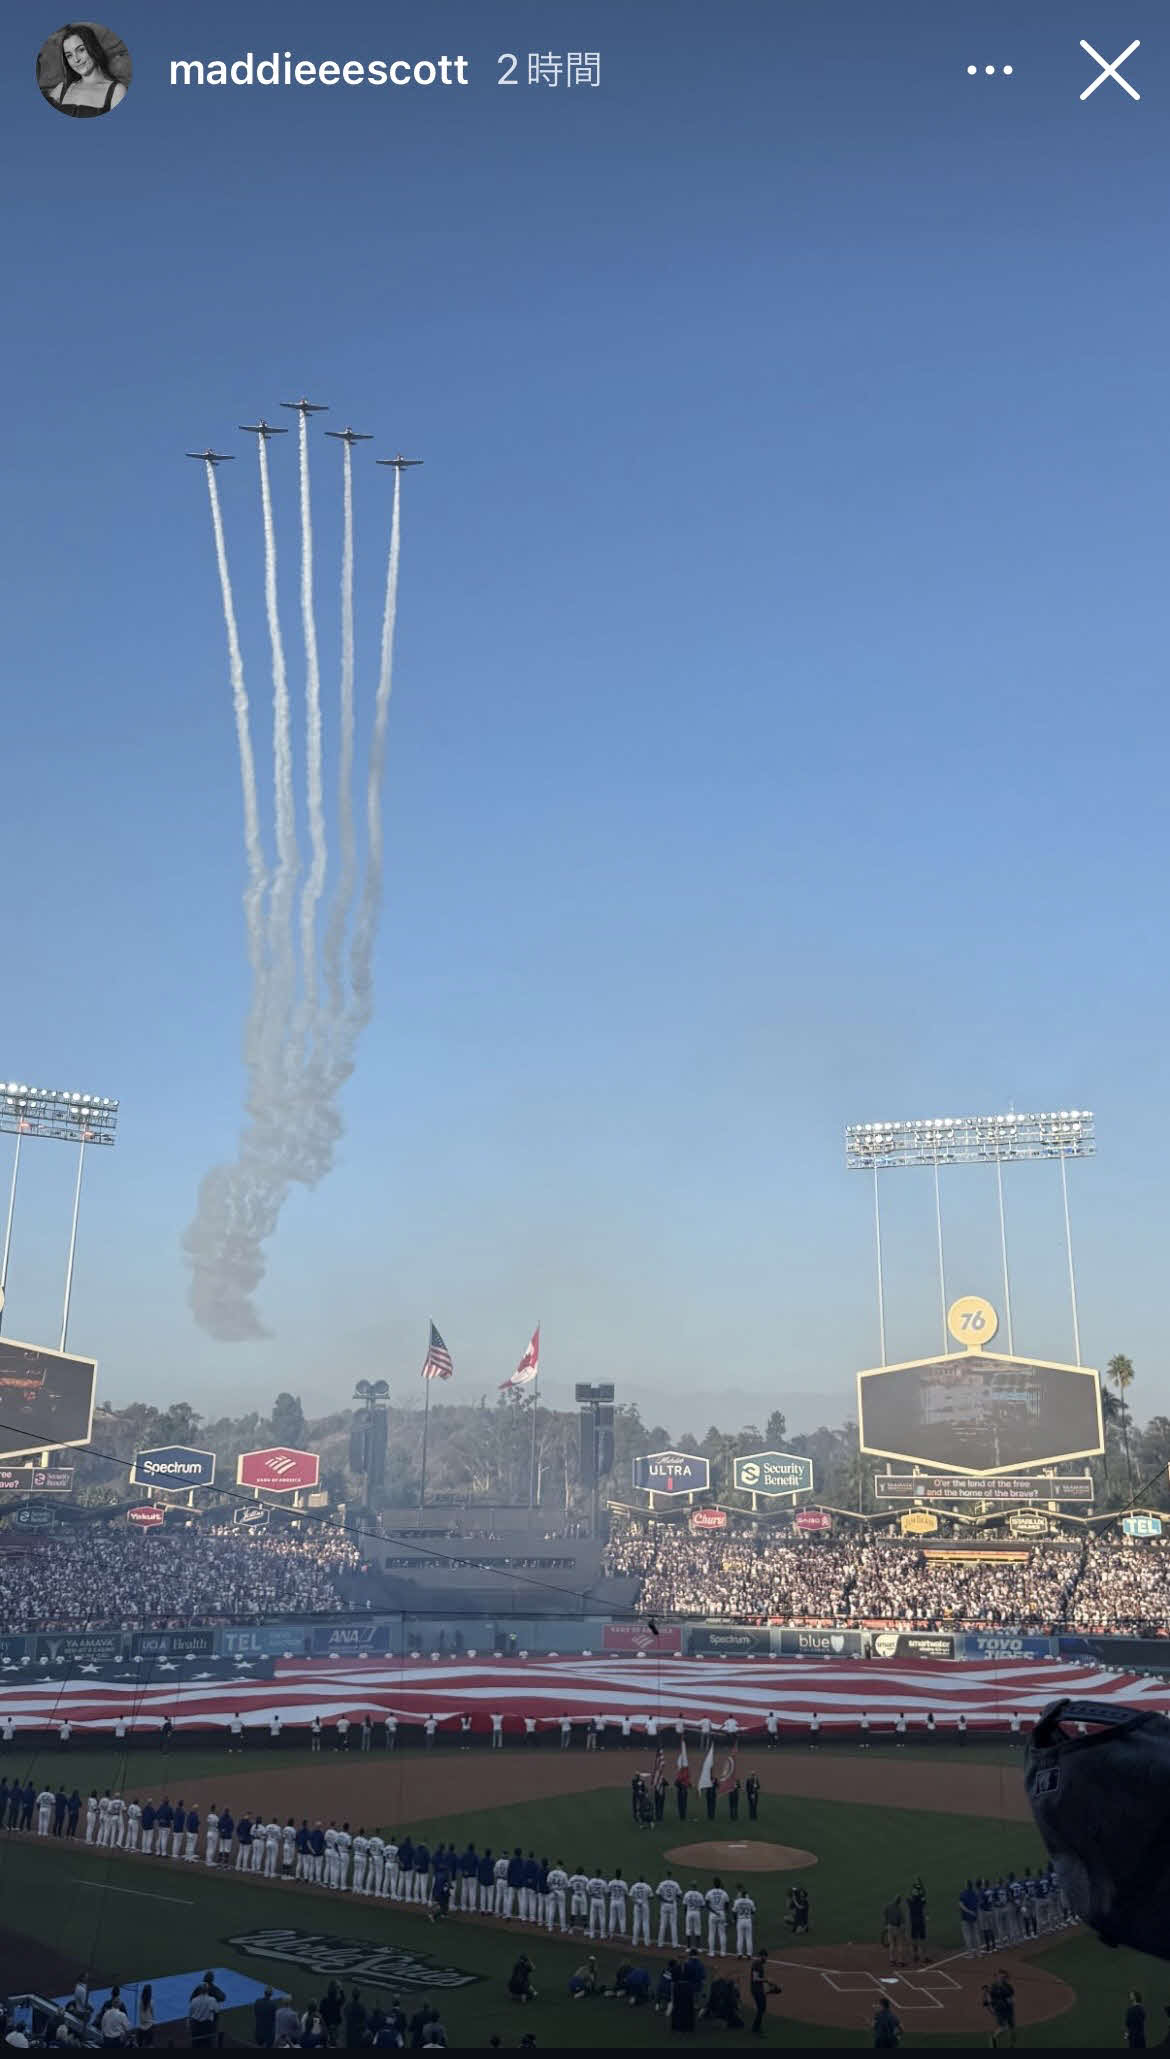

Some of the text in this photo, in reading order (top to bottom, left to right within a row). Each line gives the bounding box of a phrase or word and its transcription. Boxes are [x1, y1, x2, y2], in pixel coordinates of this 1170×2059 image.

[960, 1310, 986, 1330] 76
[143, 1461, 202, 1476] Spectrum
[649, 1465, 692, 1476] ULTRA
[763, 1463, 805, 1476] Security
[764, 1476, 800, 1486] Benefit
[952, 1479, 966, 1487] the
[967, 1479, 985, 1487] land
[987, 1479, 996, 1487] of
[997, 1480, 1011, 1488] the
[1013, 1480, 1031, 1488] free
[959, 1489, 982, 1497] home
[984, 1489, 993, 1497] of
[1010, 1490, 1039, 1498] brave?
[1127, 1519, 1158, 1534] TEL
[225, 1634, 262, 1651] TEL
[328, 1630, 359, 1643] ANA
[709, 1634, 750, 1646] Spectrum
[799, 1634, 830, 1648] blue
[143, 1637, 208, 1649] UCLA Health
[977, 1638, 1023, 1650] TOYO
